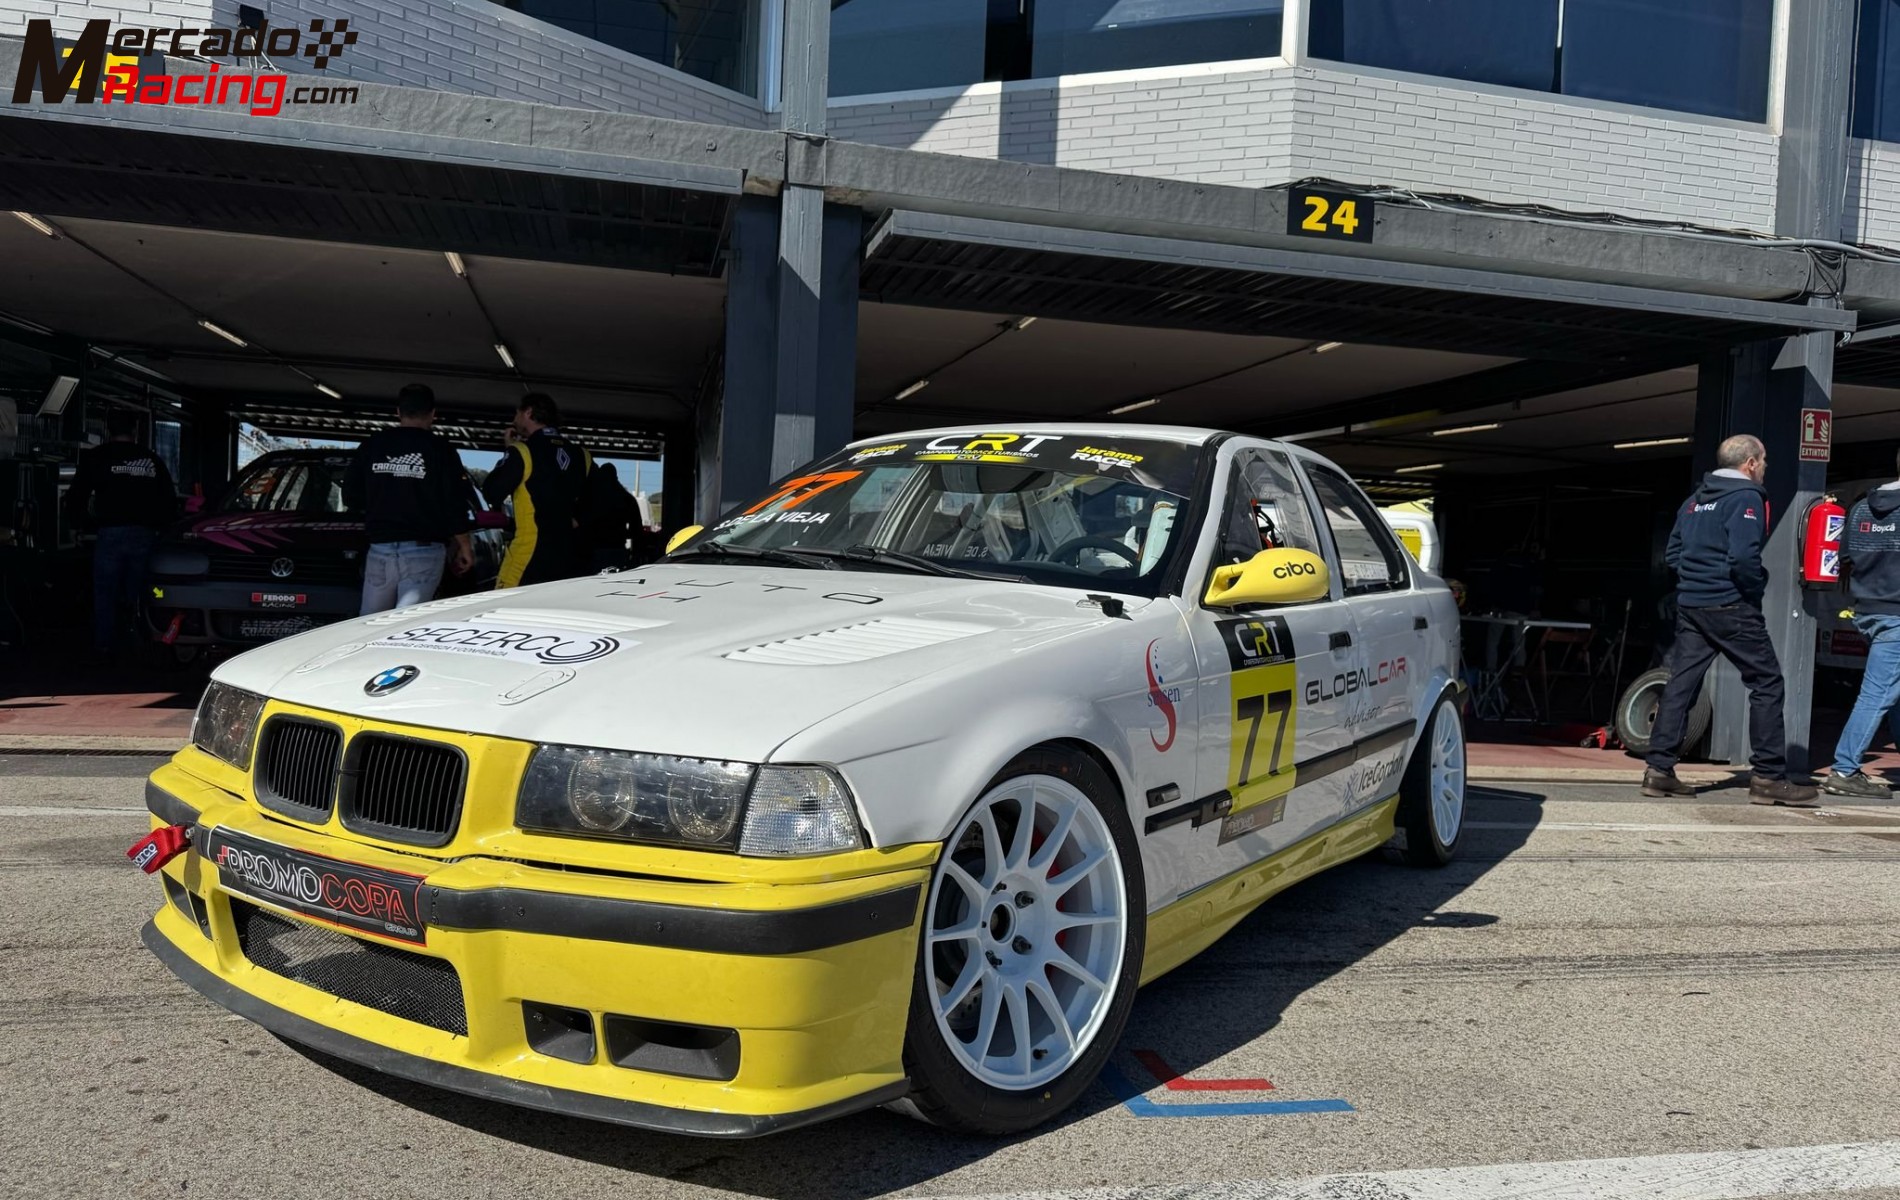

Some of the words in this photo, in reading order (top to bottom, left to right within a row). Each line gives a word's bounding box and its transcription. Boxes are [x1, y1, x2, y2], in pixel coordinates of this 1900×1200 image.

[1302, 196, 1358, 234] 24
[926, 433, 1064, 452] CRT
[1070, 452, 1136, 468] RACE
[1076, 446, 1144, 462] Jarama
[742, 470, 864, 515] 77
[776, 512, 831, 524] VIEJA
[1273, 561, 1316, 579] ciba
[263, 594, 295, 602] FERODO
[1235, 621, 1279, 657] CRT
[1237, 689, 1292, 787] 77
[385, 922, 418, 937] GROUP
